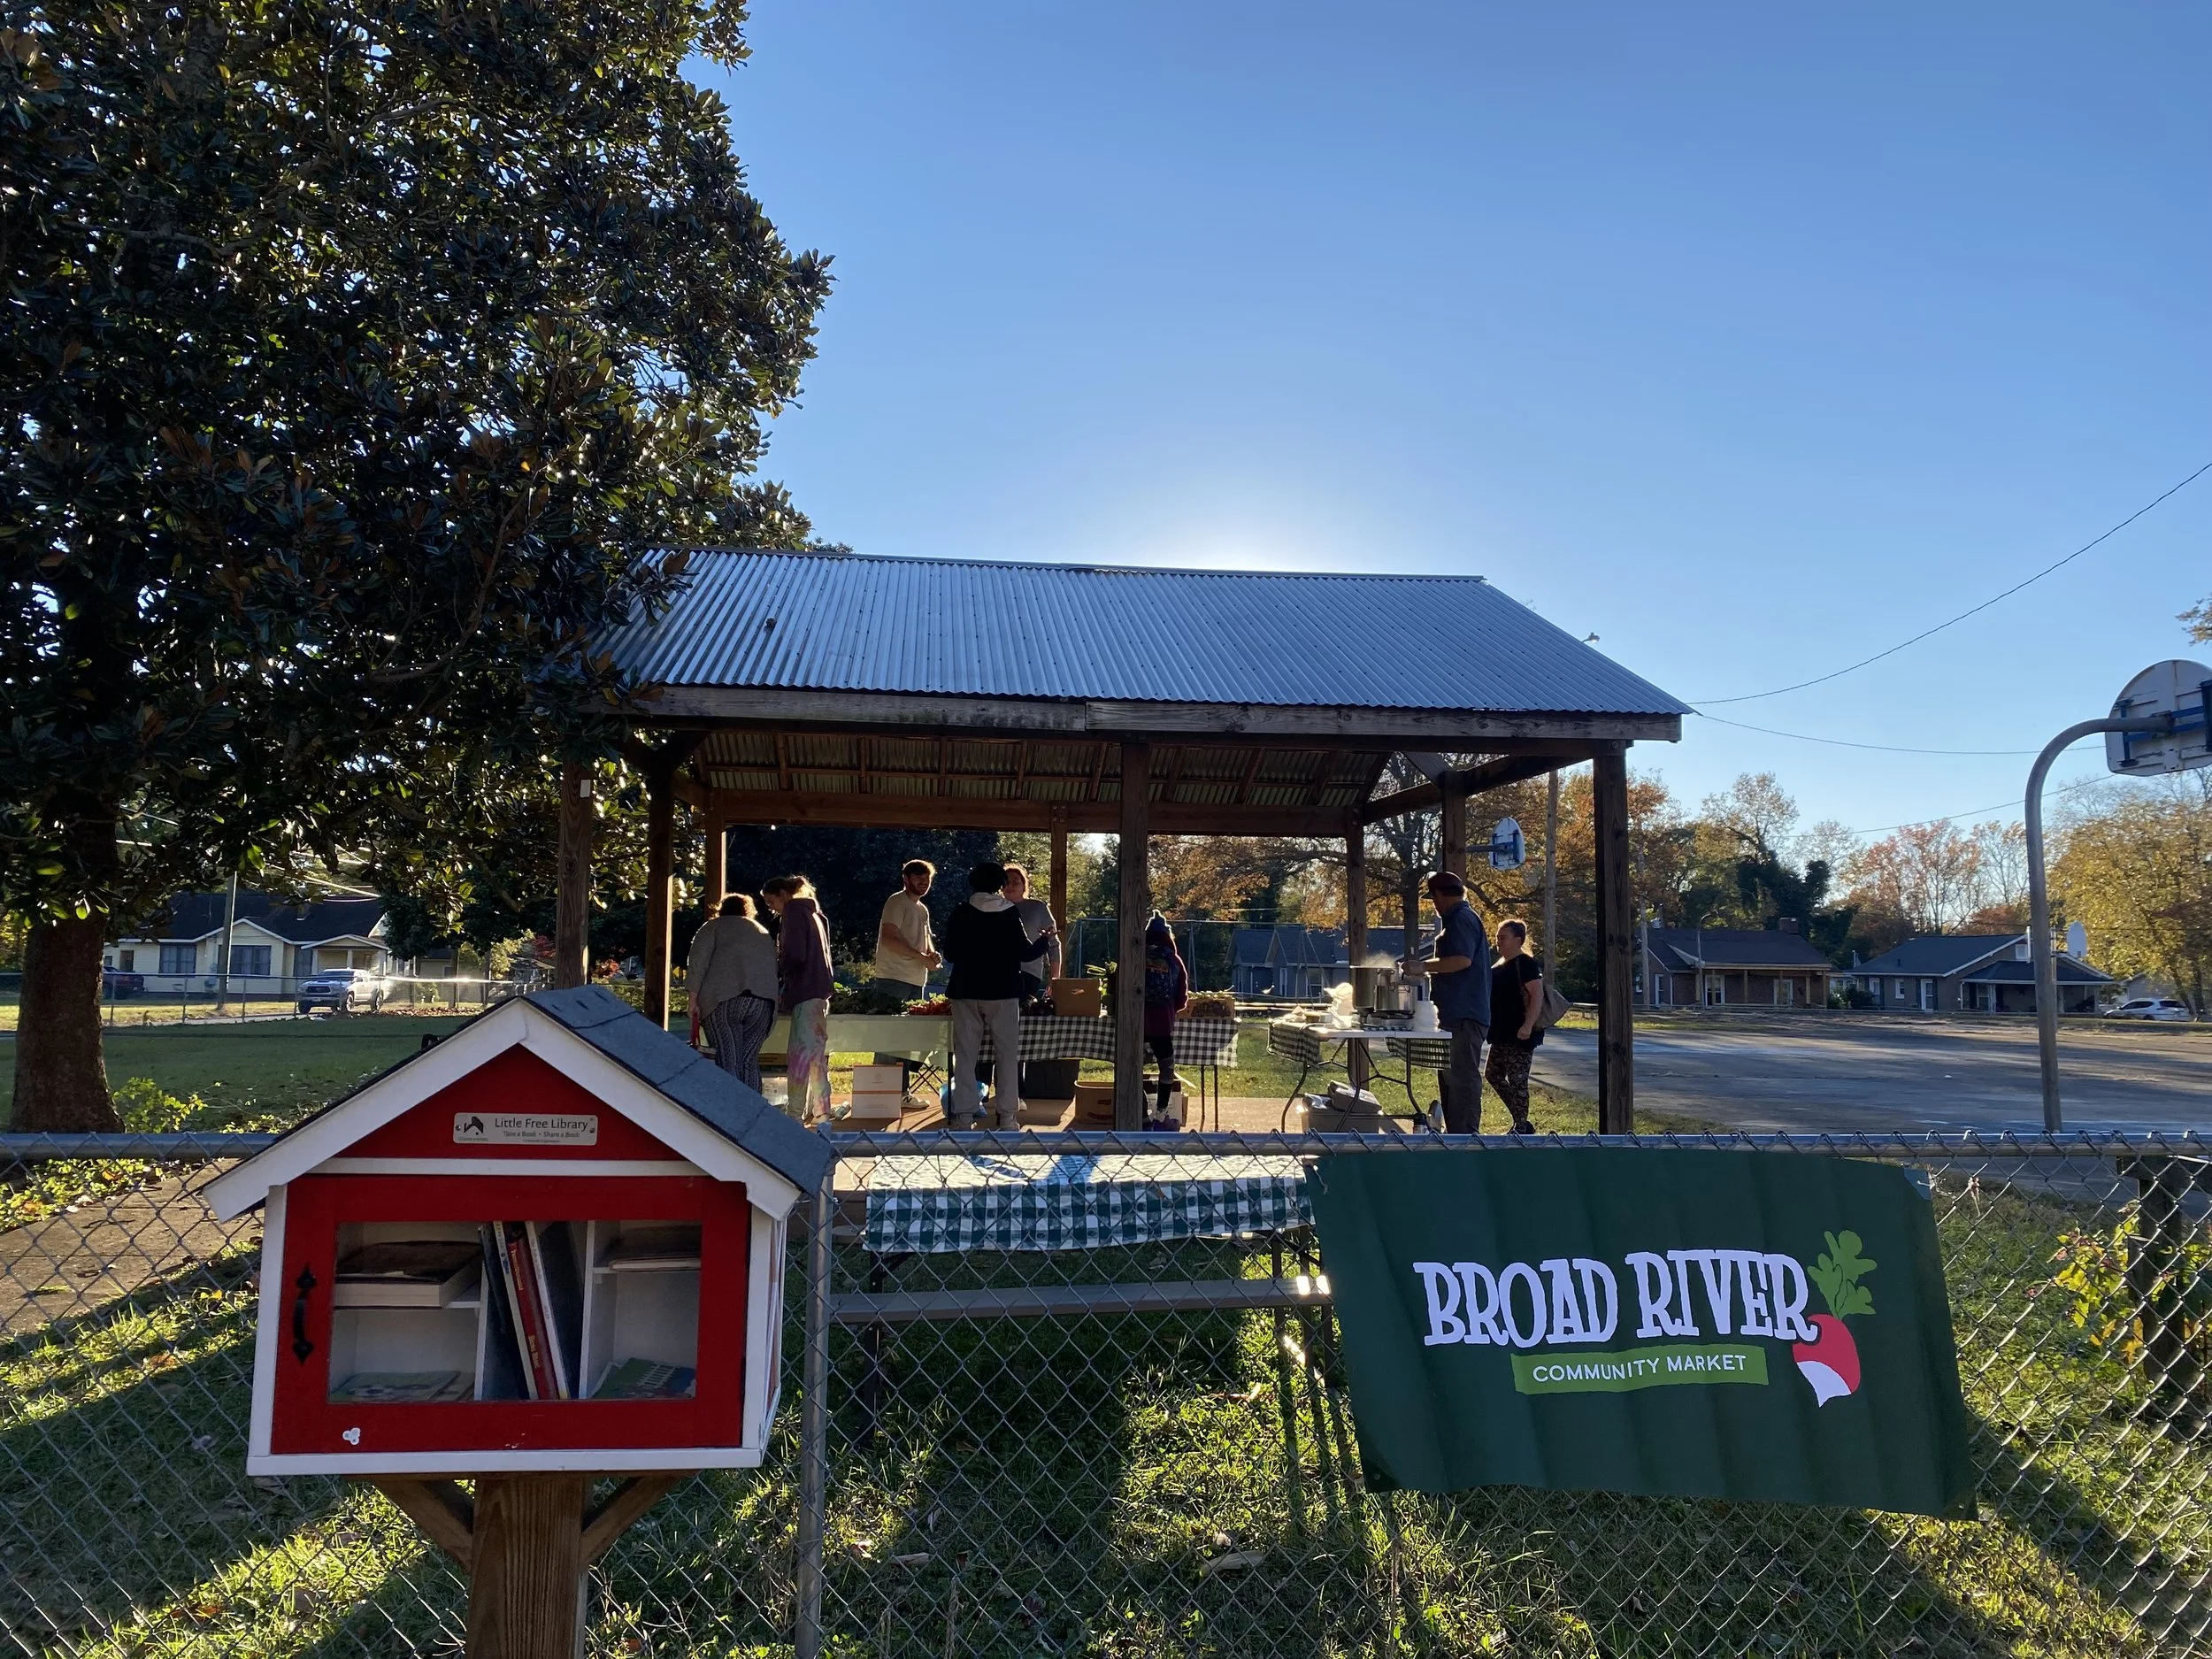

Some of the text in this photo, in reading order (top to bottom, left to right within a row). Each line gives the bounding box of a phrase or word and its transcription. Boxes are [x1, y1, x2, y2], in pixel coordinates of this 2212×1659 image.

[495, 1118, 588, 1133] Little Free Library
[1413, 1248, 1818, 1348] BROAD RIVER
[1532, 1354, 1747, 1382] COMMUNITY MARKET
